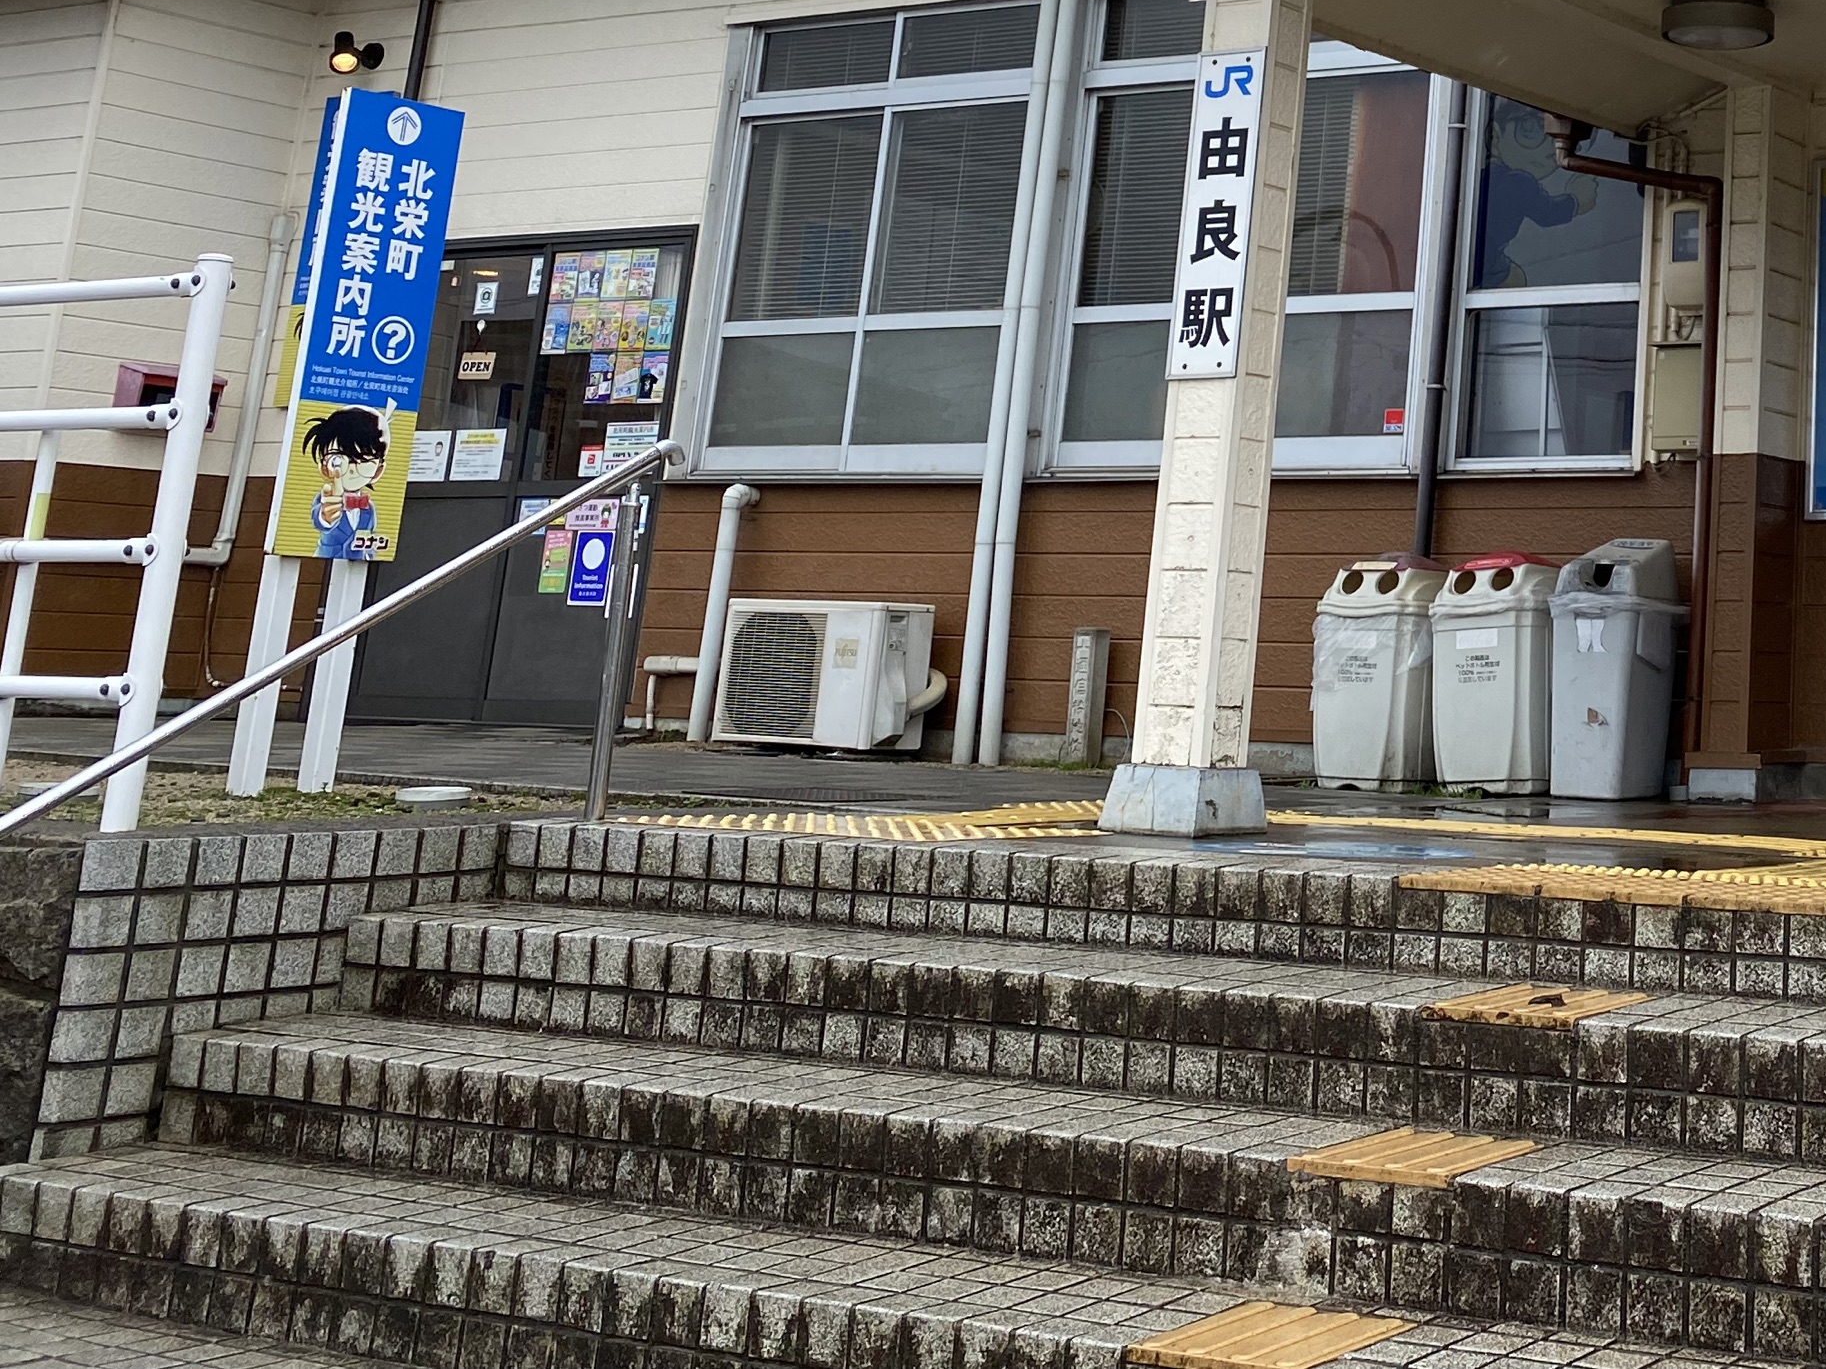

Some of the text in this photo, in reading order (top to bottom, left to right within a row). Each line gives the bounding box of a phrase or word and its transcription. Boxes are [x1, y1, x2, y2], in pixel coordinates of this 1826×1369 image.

[1204, 65, 1253, 98] JR
[326, 148, 394, 358] 観光案内所
[385, 159, 436, 280] 北栄町
[1179, 117, 1249, 348] 由良駅
[462, 361, 491, 373] OPEN
[353, 535, 390, 550] コナン
